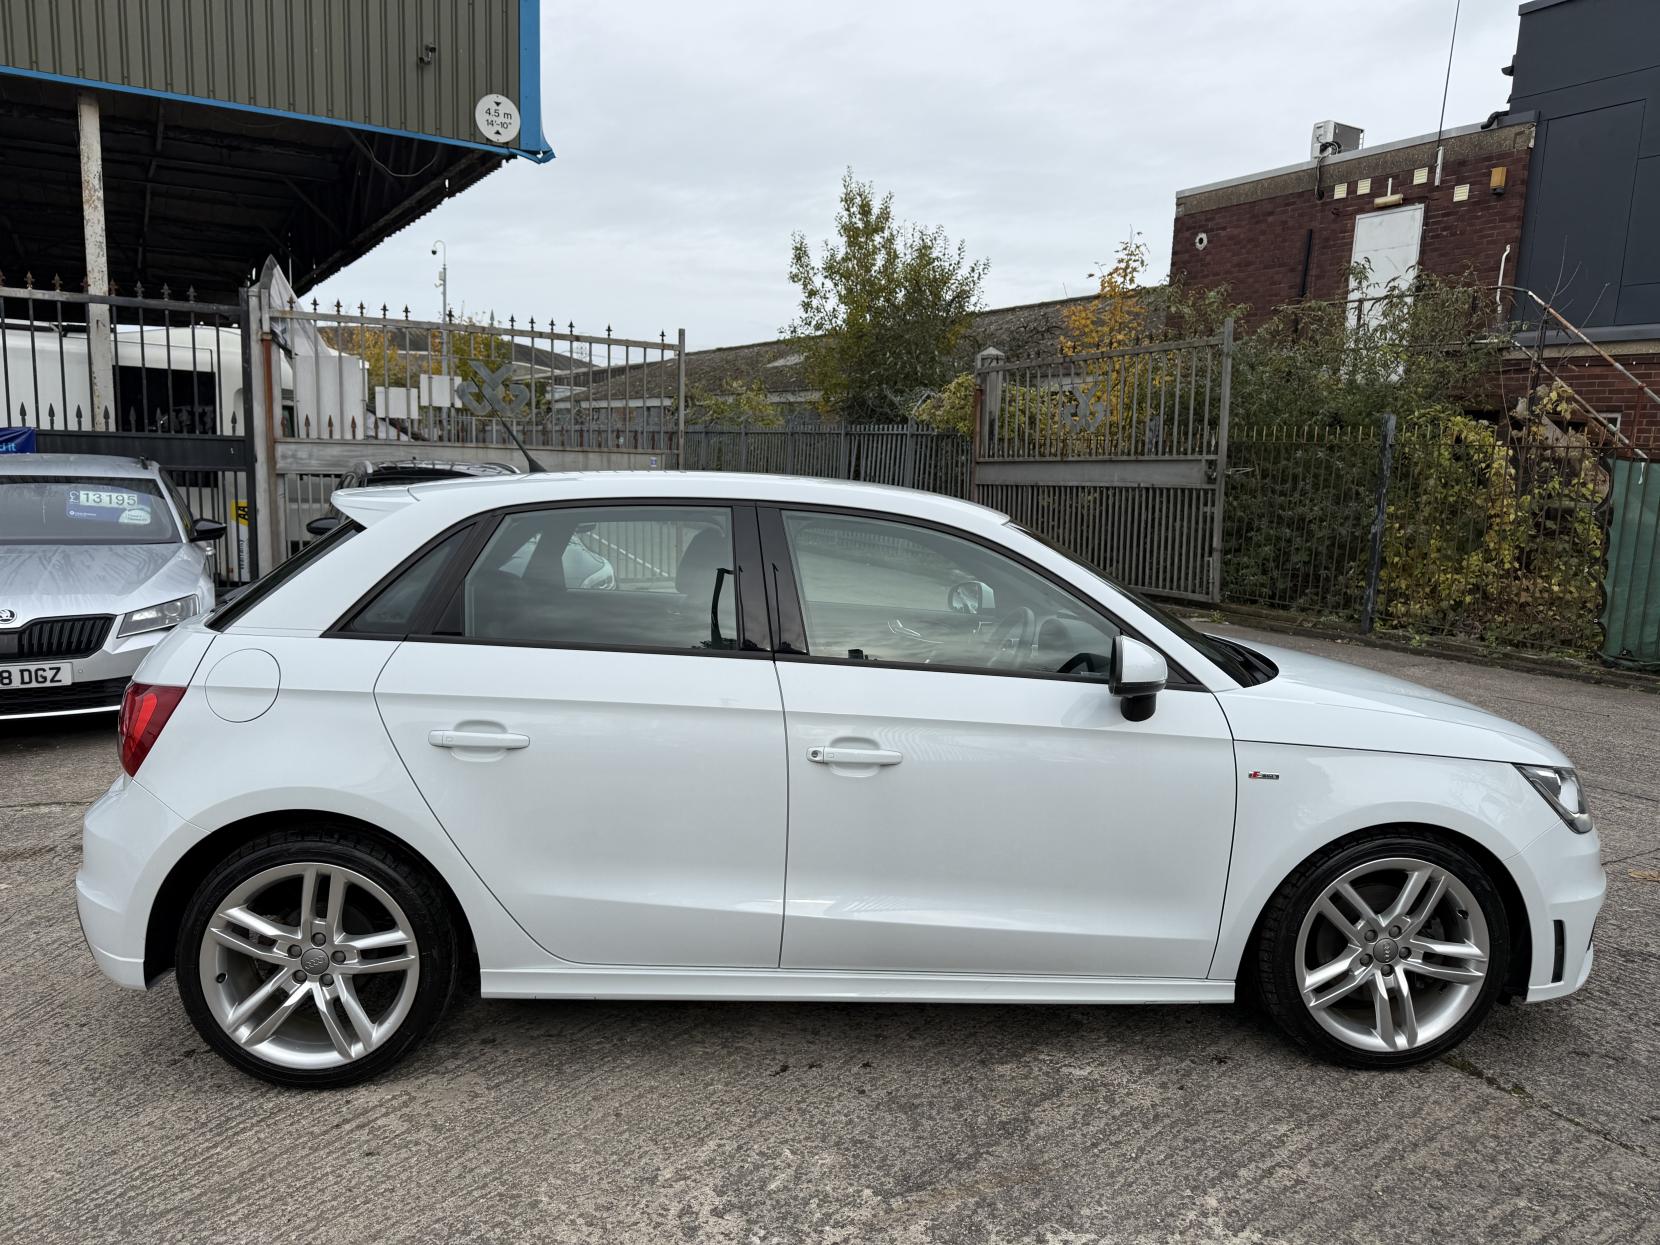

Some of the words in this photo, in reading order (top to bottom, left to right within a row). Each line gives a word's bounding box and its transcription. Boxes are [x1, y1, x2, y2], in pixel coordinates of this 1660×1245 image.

[485, 108, 500, 118] 4.5
[503, 112, 513, 120] m
[19, 667, 62, 685] DGZ
